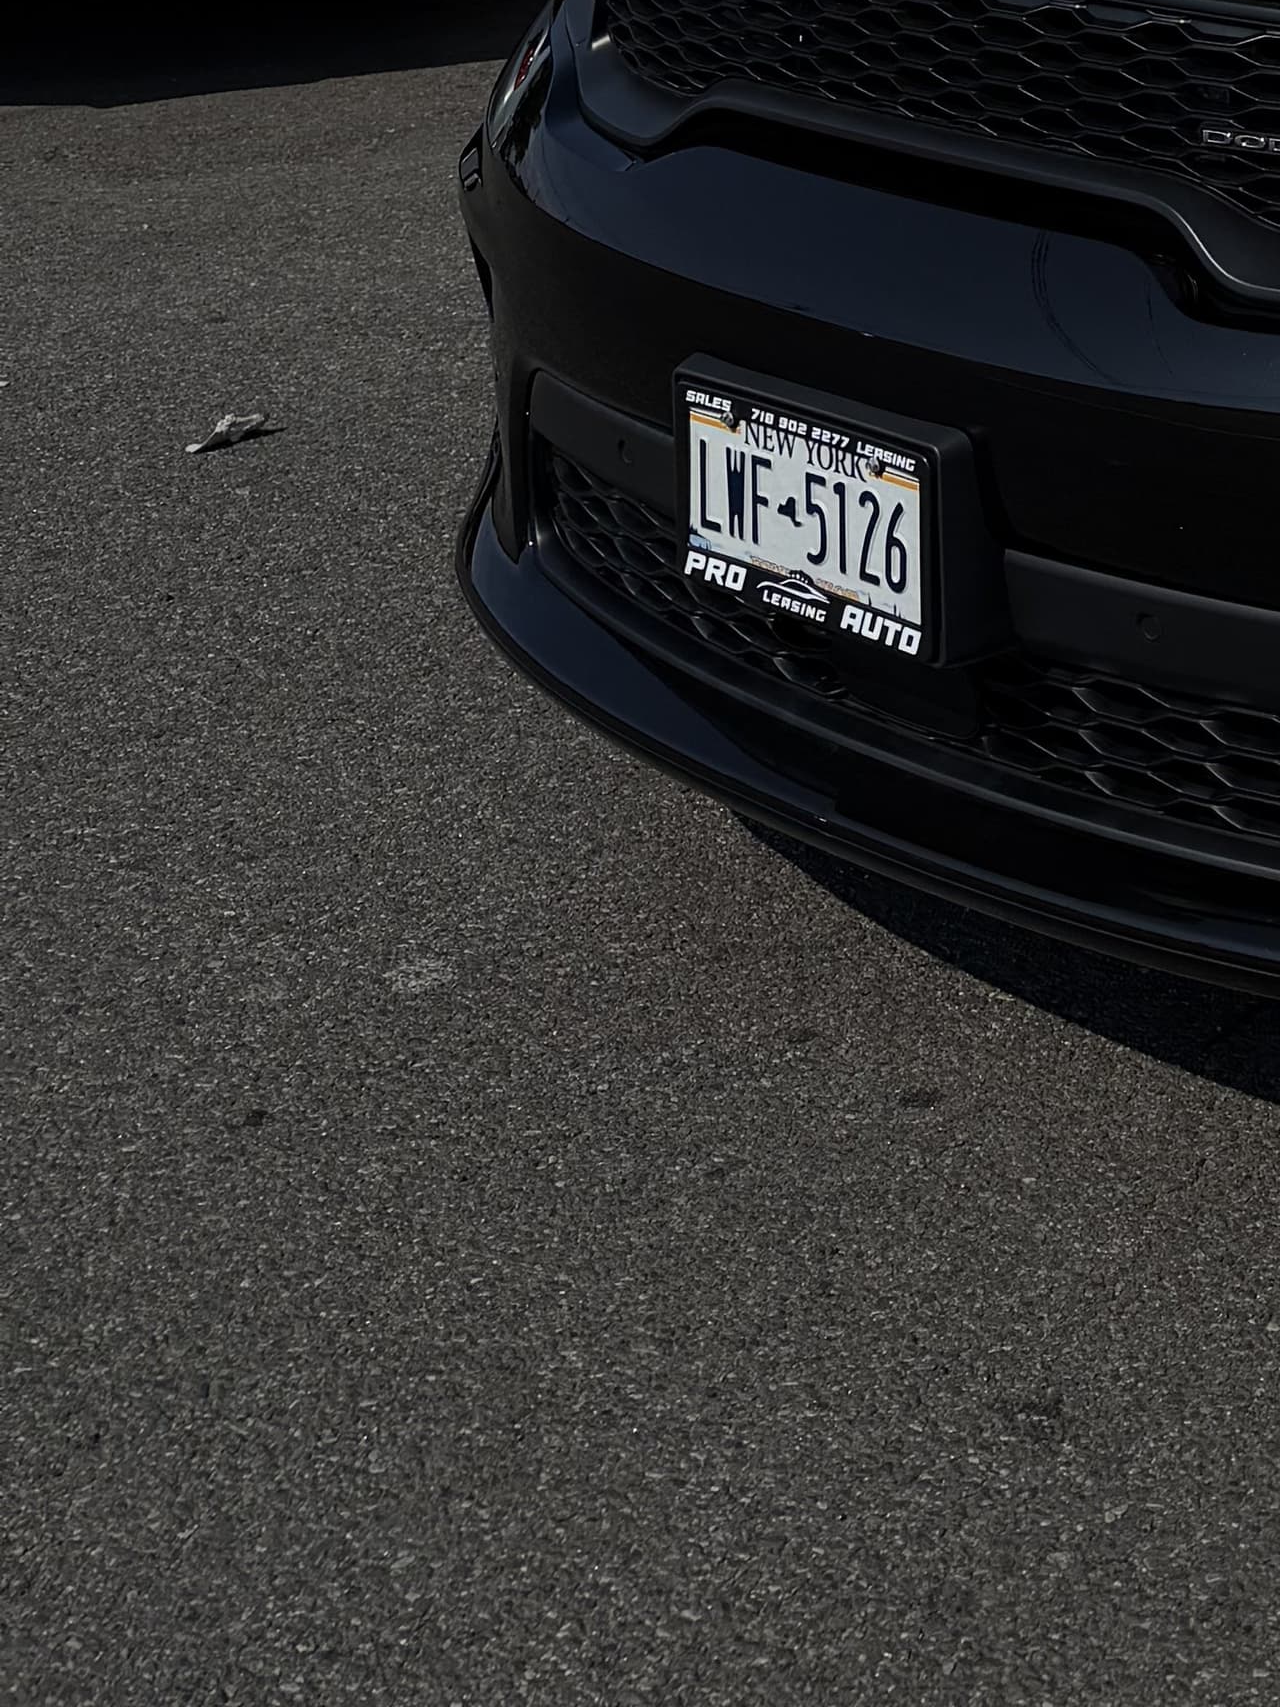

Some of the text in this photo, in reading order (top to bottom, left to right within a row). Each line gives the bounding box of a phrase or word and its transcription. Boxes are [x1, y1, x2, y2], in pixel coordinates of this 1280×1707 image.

[685, 390, 916, 473] SALES 718 902 2277 LEASING
[744, 421, 868, 484] NEW YORK
[684, 549, 748, 592] PRO
[762, 589, 827, 623] LEASING
[840, 604, 922, 656] AUTO
